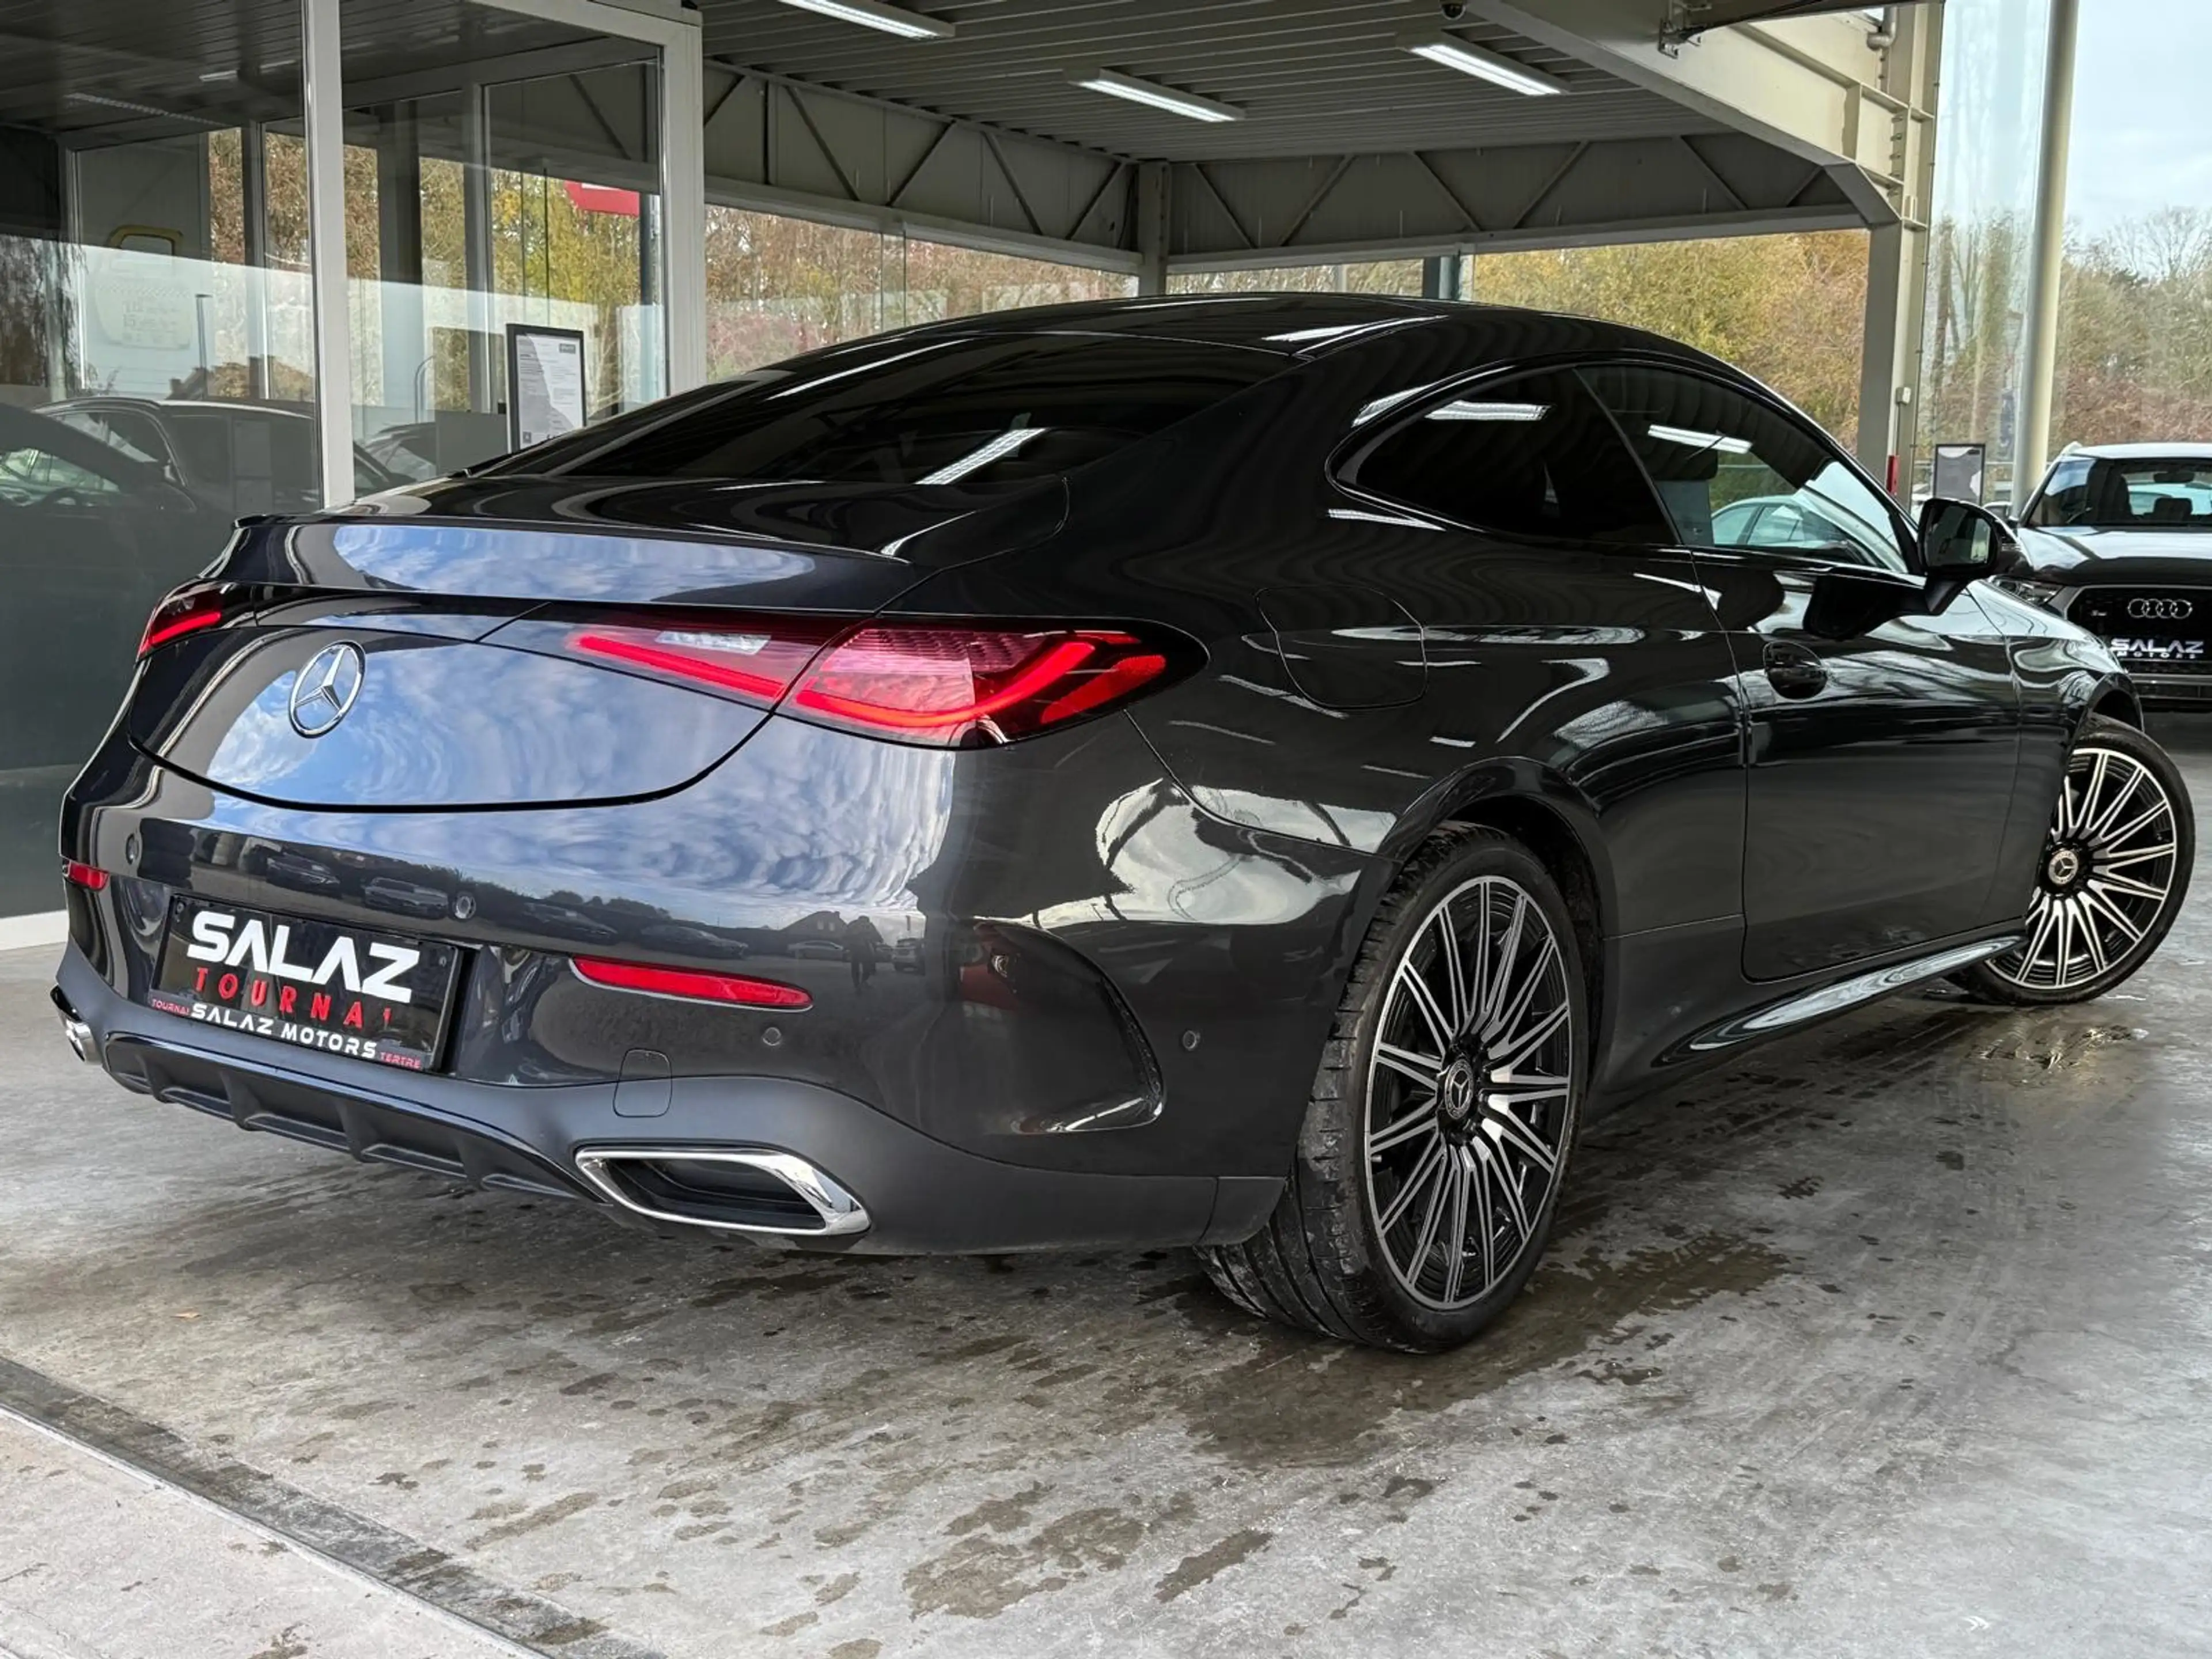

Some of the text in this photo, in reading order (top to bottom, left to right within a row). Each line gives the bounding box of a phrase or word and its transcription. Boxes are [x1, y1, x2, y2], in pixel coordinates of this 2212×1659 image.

[2109, 638, 2203, 653] SALAZ
[187, 911, 420, 1003] SALAZ
[151, 998, 422, 1070] TOURNAI SALAZ MOTORS TERTRE
